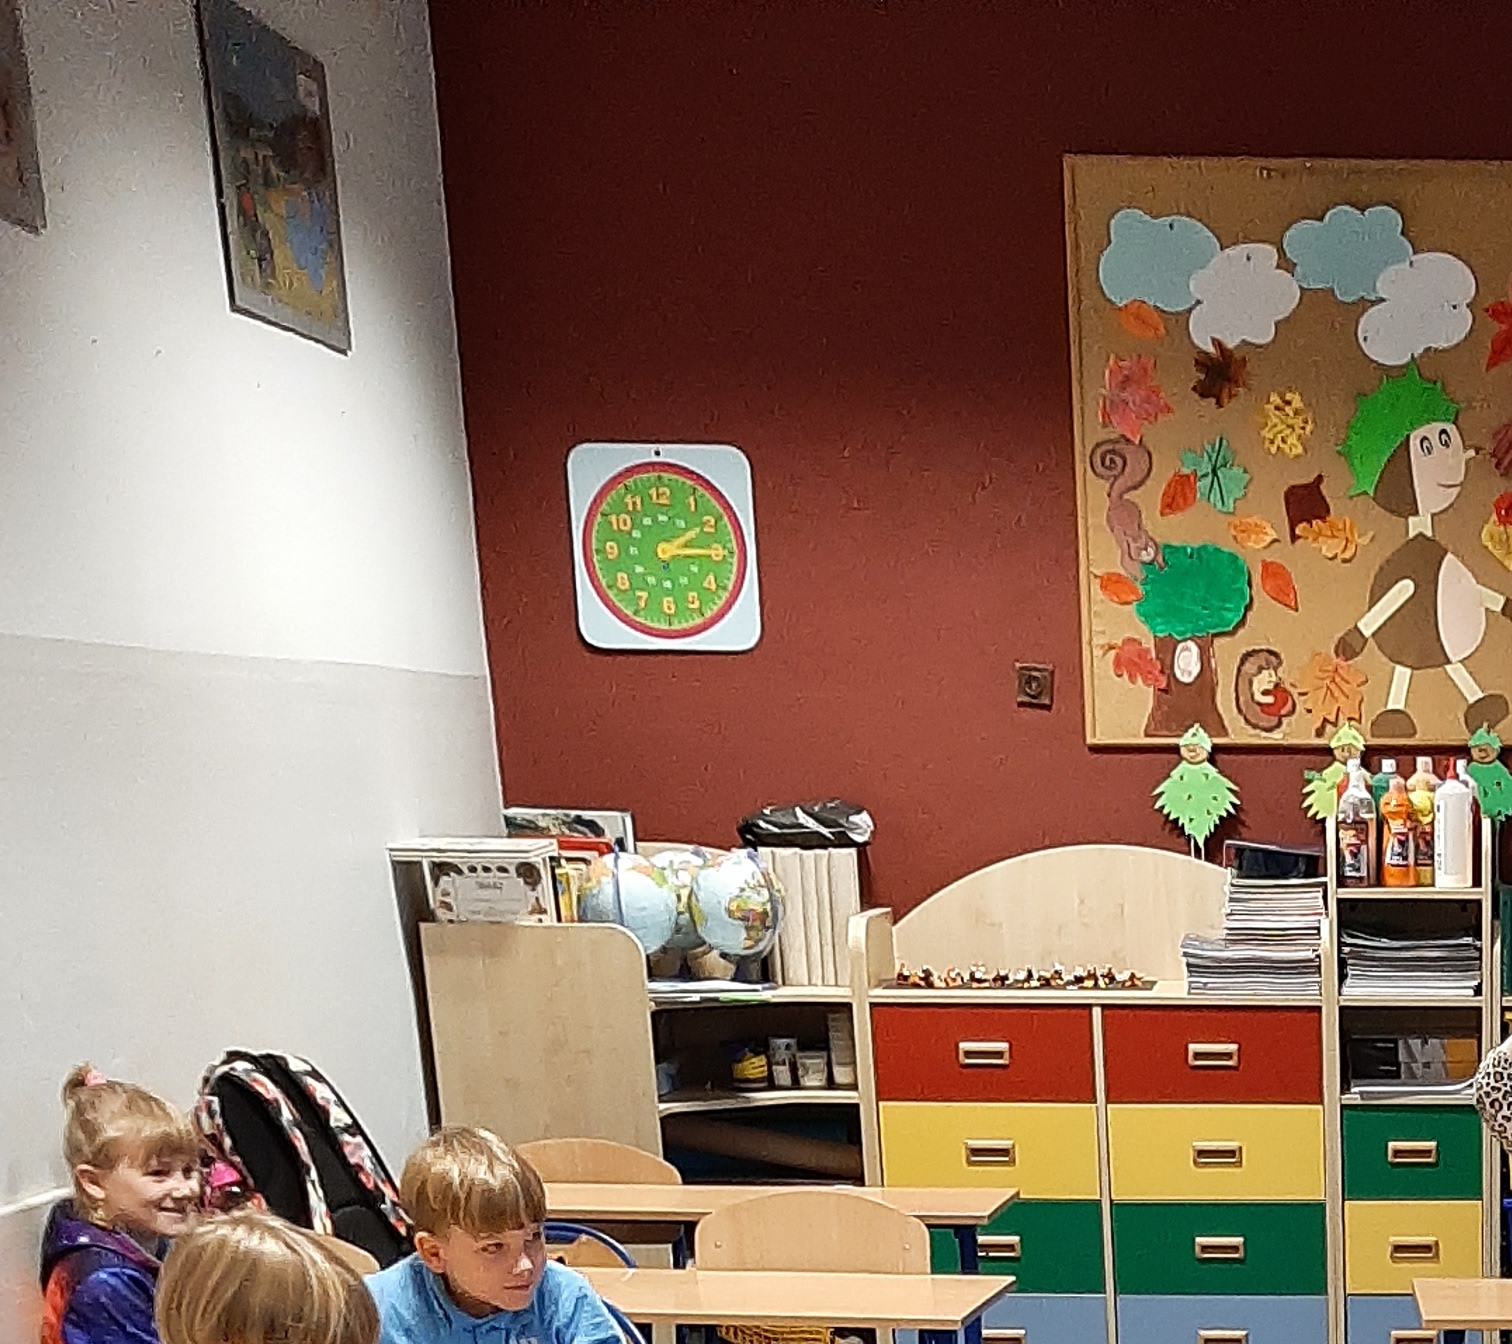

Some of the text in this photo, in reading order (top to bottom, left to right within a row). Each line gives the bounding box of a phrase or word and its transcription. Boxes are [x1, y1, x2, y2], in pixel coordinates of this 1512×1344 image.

[625, 494, 642, 512] 11
[649, 486, 670, 506] 12
[688, 496, 697, 512] 1
[609, 513, 632, 532] 10
[702, 515, 716, 533] 2
[605, 541, 618, 560] 9
[616, 572, 630, 591] 8
[703, 573, 717, 592] 4
[635, 591, 648, 609] 7
[662, 596, 676, 615] 6
